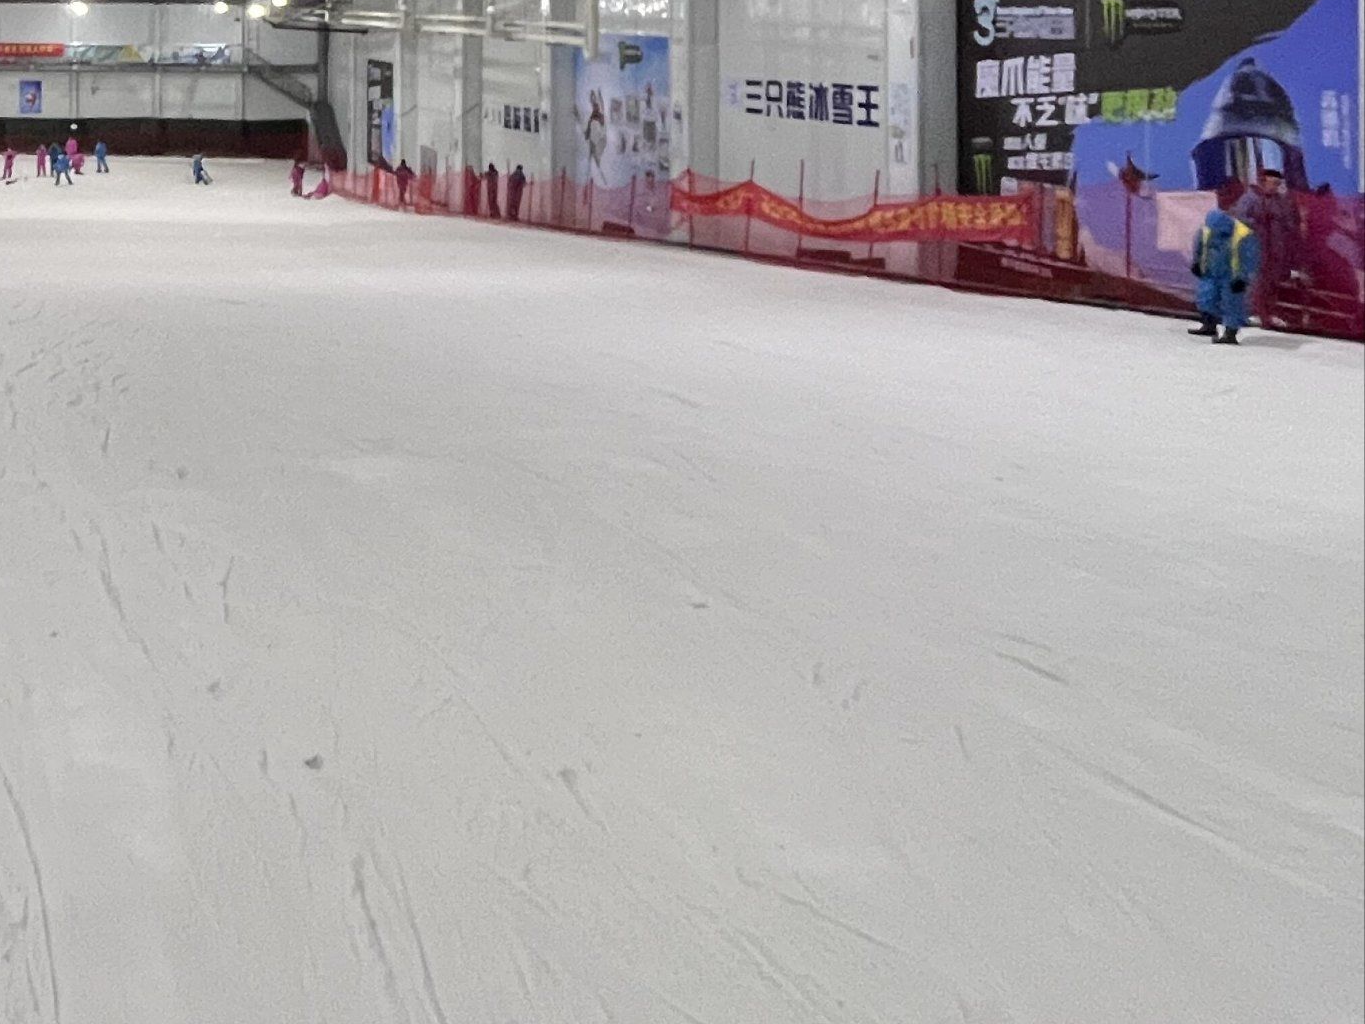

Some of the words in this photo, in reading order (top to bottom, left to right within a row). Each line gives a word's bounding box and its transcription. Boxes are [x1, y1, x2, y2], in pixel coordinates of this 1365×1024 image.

[745, 79, 880, 127] 三只熊冰雪王
